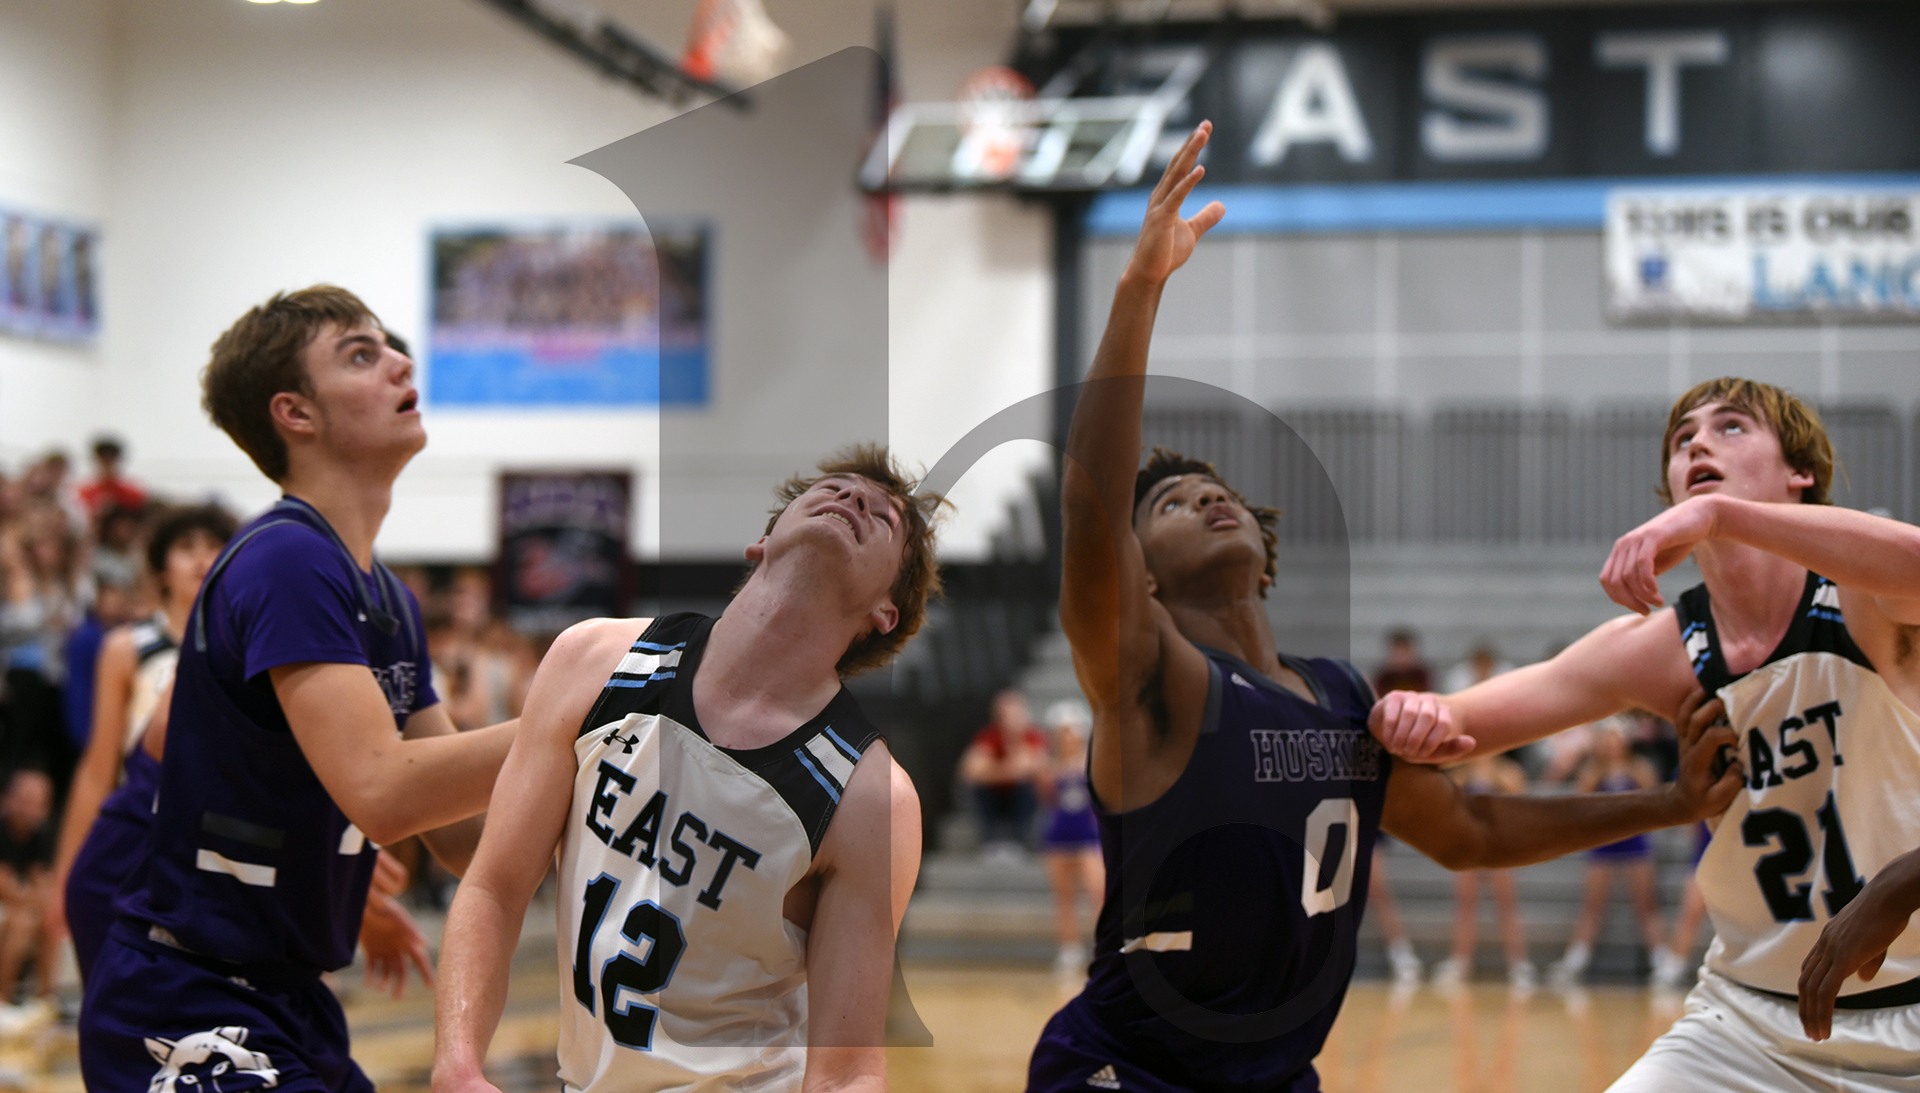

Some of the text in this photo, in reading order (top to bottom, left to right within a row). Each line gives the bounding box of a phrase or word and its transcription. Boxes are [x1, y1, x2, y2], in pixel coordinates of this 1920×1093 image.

[586, 758, 762, 912] EAST
[1301, 797, 1360, 918] 0
[1740, 788, 1867, 923] 21
[573, 871, 688, 1053] 12
